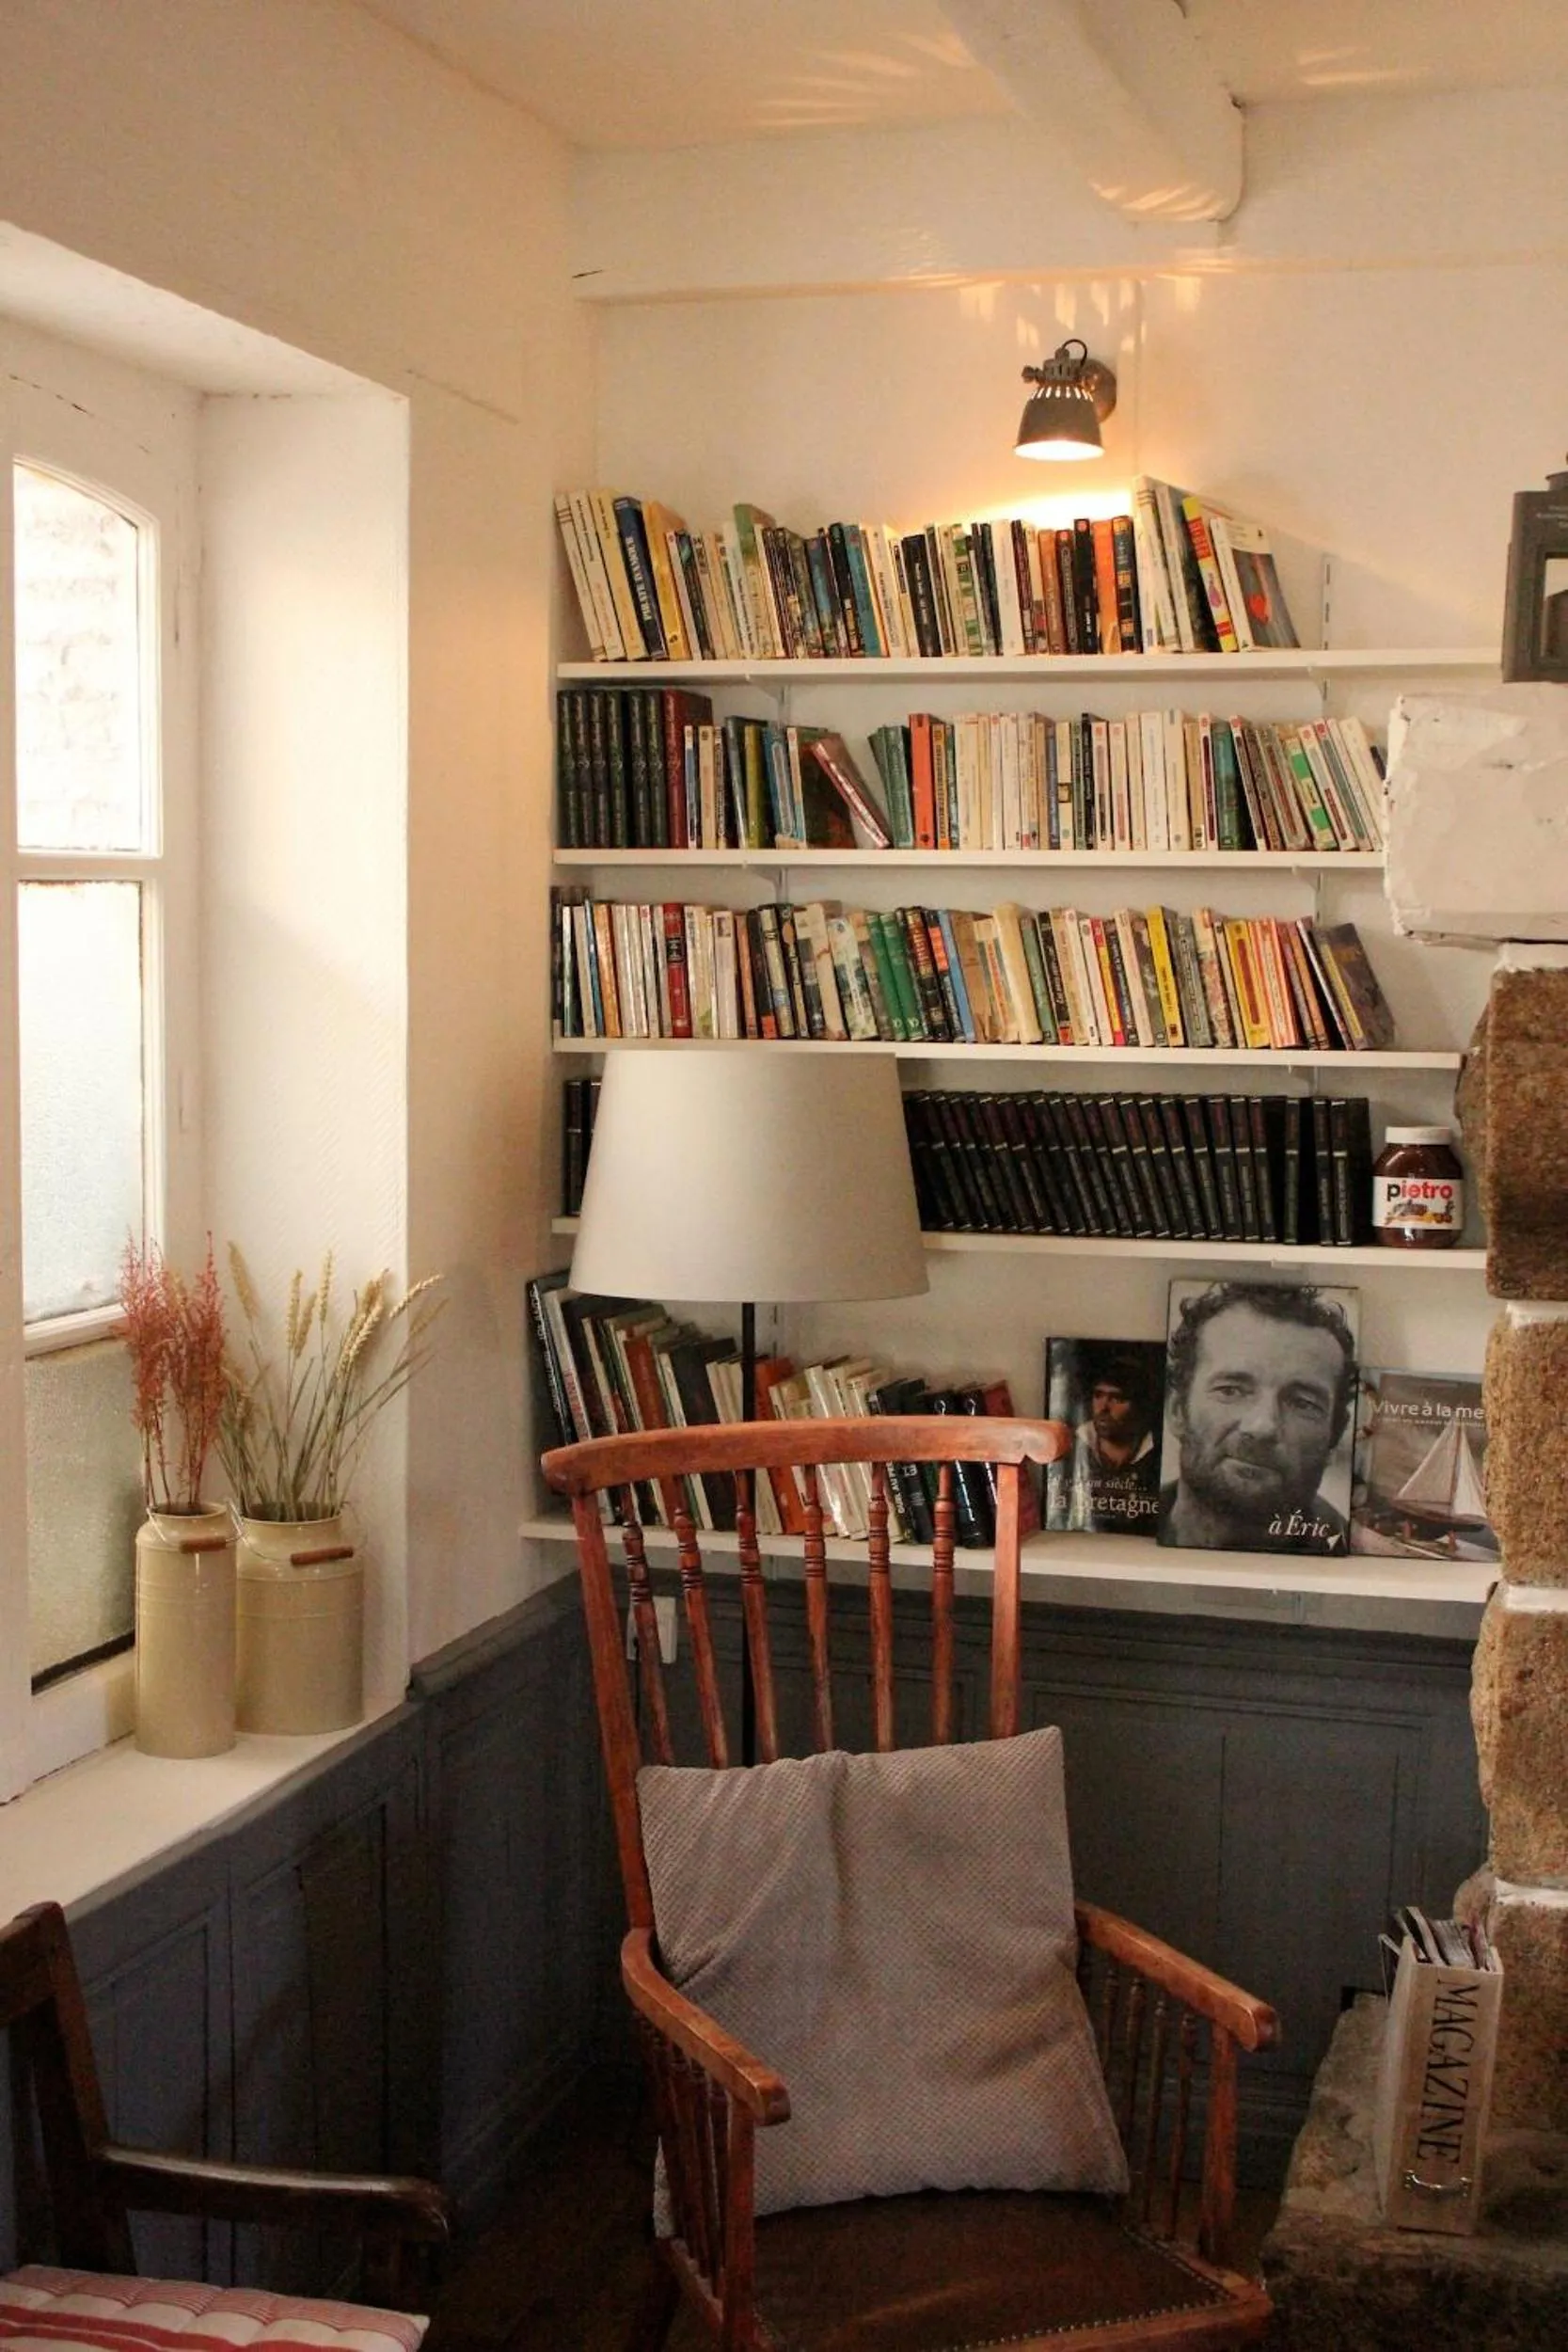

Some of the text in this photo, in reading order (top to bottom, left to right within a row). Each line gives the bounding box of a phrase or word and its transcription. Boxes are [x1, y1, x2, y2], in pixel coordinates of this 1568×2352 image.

[1386, 1180, 1453, 1202] pietro
[1373, 1399, 1486, 1420] Vivre à la me
[1078, 1494, 1160, 1519] retagne
[1268, 1509, 1331, 1538] à Éric
[1417, 1979, 1481, 2164] MAGAZINE
